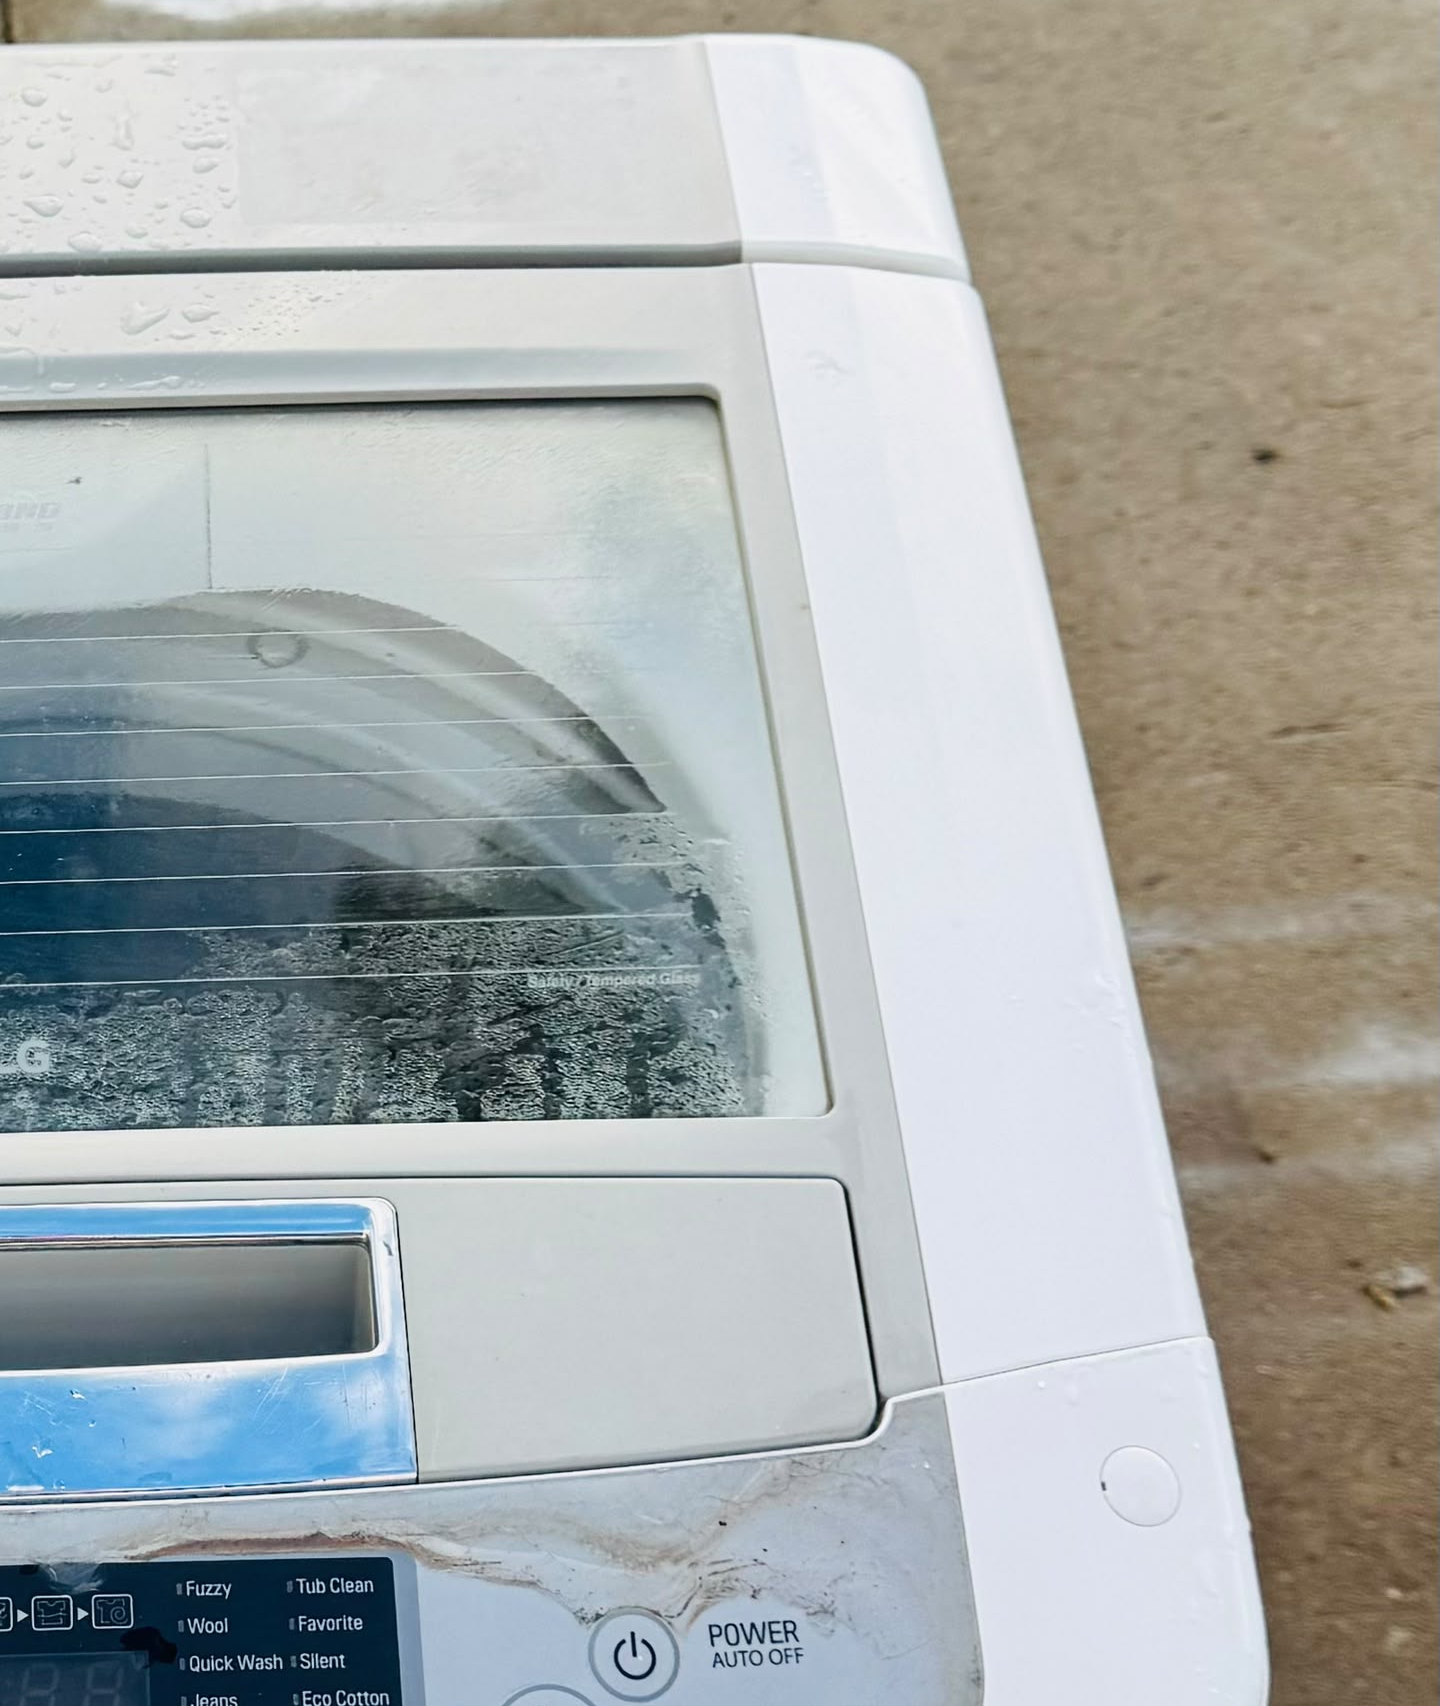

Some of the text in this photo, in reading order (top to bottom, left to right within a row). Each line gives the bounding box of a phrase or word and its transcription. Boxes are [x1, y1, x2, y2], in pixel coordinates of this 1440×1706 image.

[185, 1580, 232, 1600] Fuzzy
[295, 1577, 375, 1595] Tub Clean
[187, 1617, 229, 1635] Wool
[298, 1614, 364, 1633] Favorite
[707, 1619, 800, 1647] POWER
[189, 1654, 284, 1673] Quick Wash
[299, 1652, 346, 1670] Silent
[712, 1647, 804, 1669] AUTO OFF
